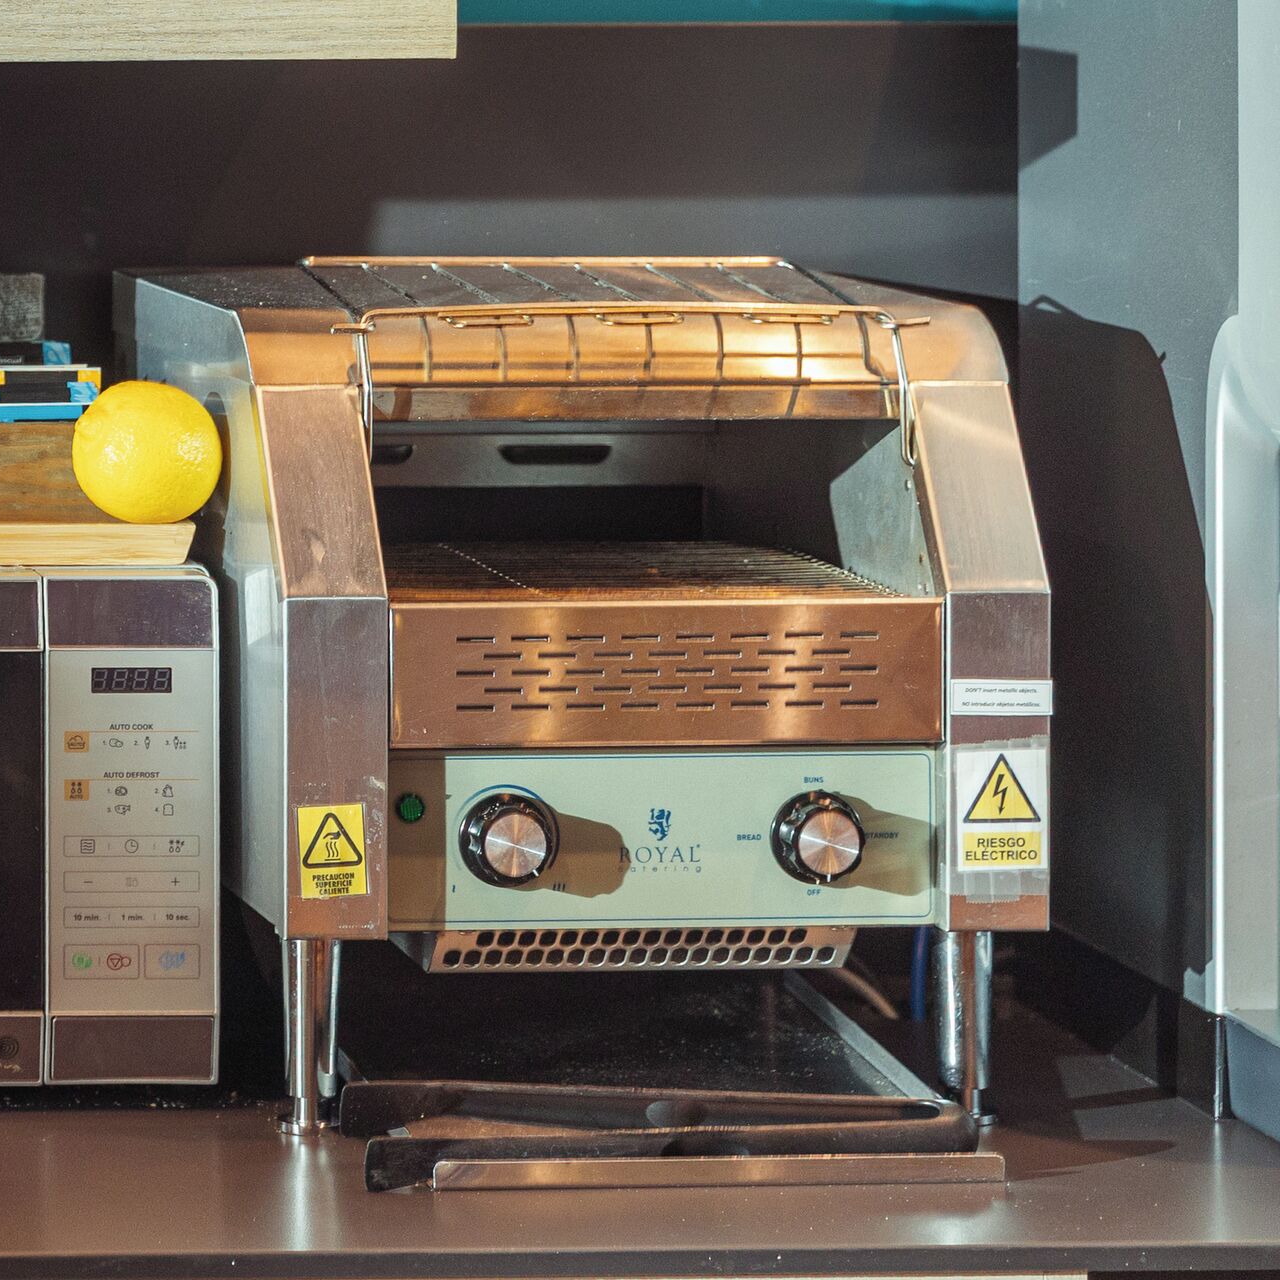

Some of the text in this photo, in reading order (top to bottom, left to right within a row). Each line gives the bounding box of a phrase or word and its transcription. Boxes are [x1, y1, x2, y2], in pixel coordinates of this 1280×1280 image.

[803, 776, 824, 784] BUNS
[977, 837, 1026, 848] RIESGO
[619, 846, 701, 864] ROYAL
[965, 848, 1038, 862] ELÉCTRICO
[312, 872, 354, 882] PRECAUCION
[315, 880, 352, 888] SUPERFICIE
[318, 886, 350, 896] CALIENTE
[806, 888, 821, 896] OFF
